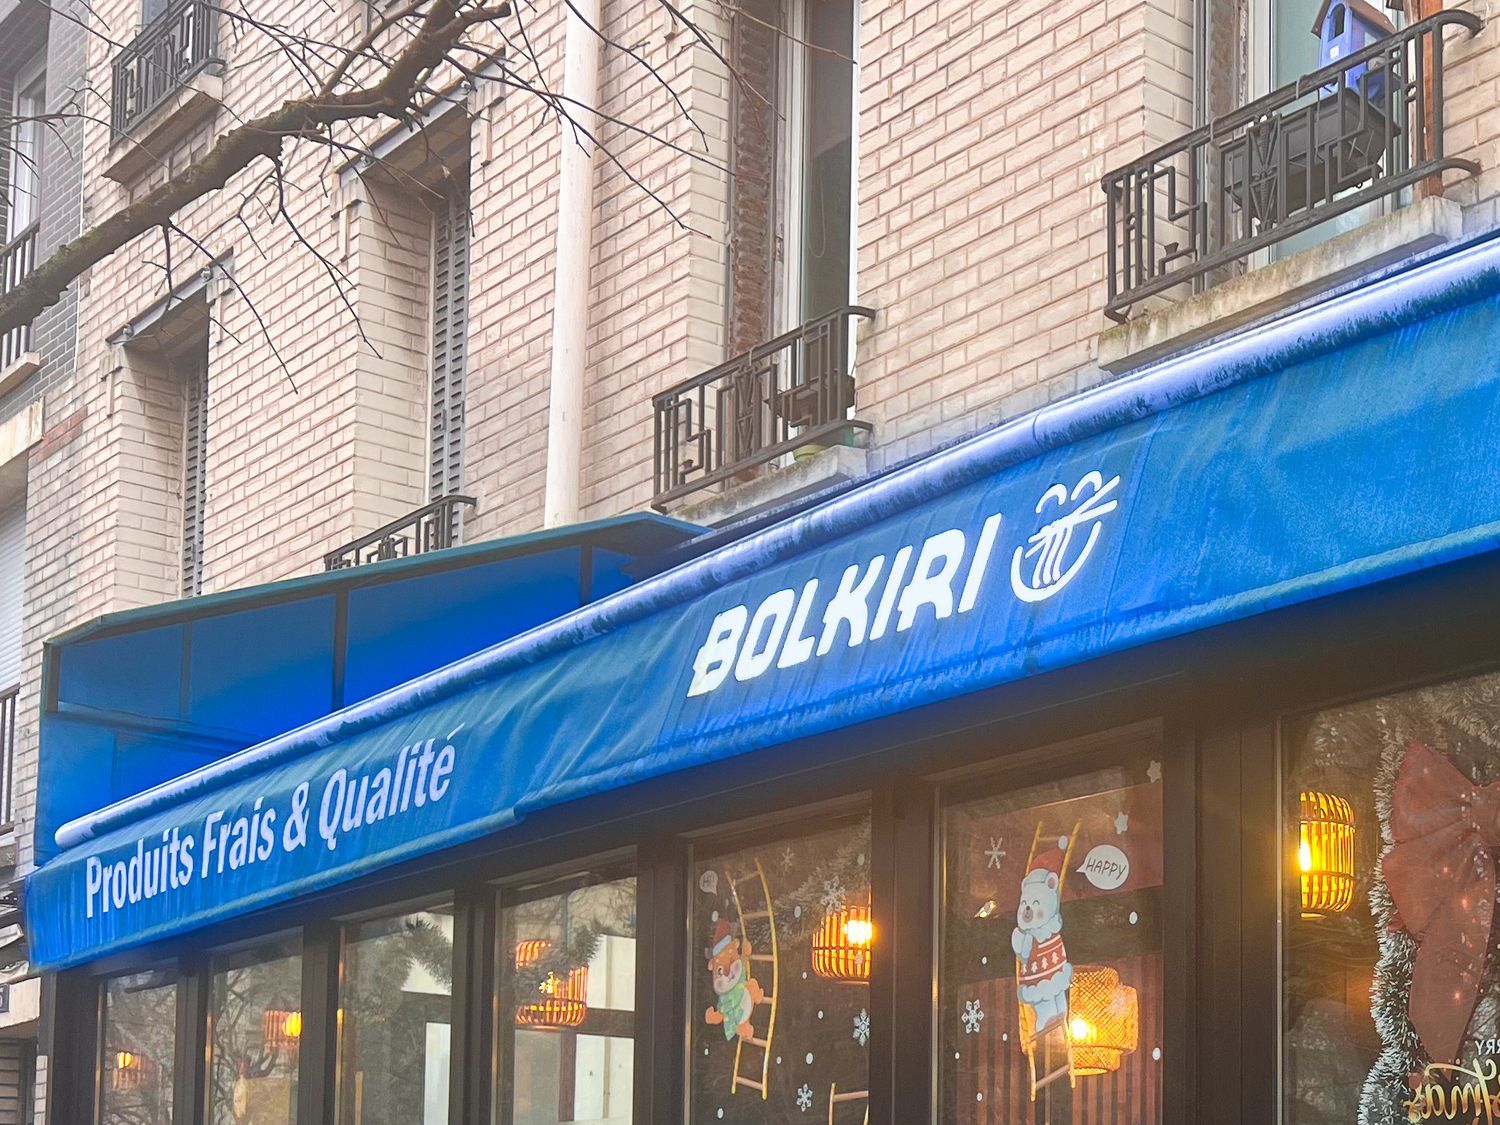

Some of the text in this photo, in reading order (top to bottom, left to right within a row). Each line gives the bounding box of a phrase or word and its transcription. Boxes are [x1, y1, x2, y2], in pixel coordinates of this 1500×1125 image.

[686, 512, 1002, 699] BOLKIRI
[86, 722, 466, 919] Produits Frais & Qualité
[1085, 856, 1128, 881] HAPPY
